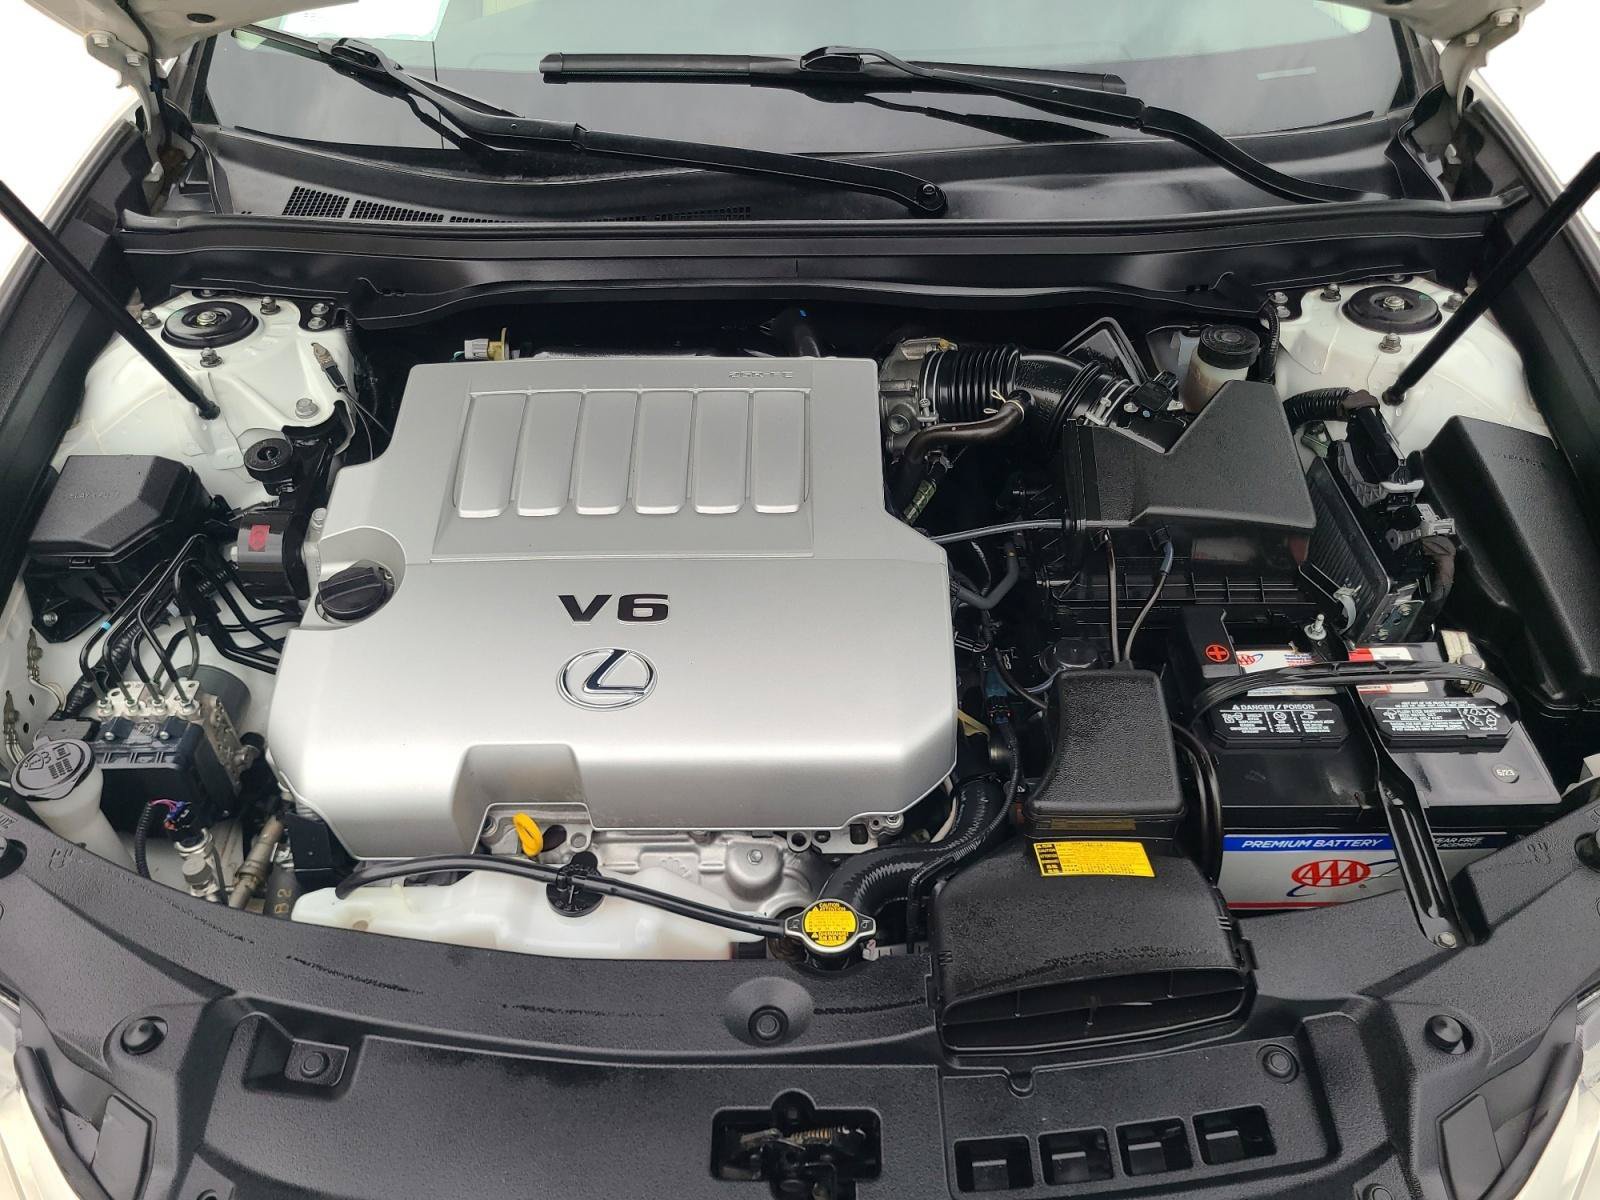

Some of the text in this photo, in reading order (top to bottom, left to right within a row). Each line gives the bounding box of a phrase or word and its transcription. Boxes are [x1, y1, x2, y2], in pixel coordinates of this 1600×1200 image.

[558, 593, 669, 622] V6
[1241, 838, 1384, 849] PREMIUM BATTERY
[1293, 859, 1371, 887] AAA
